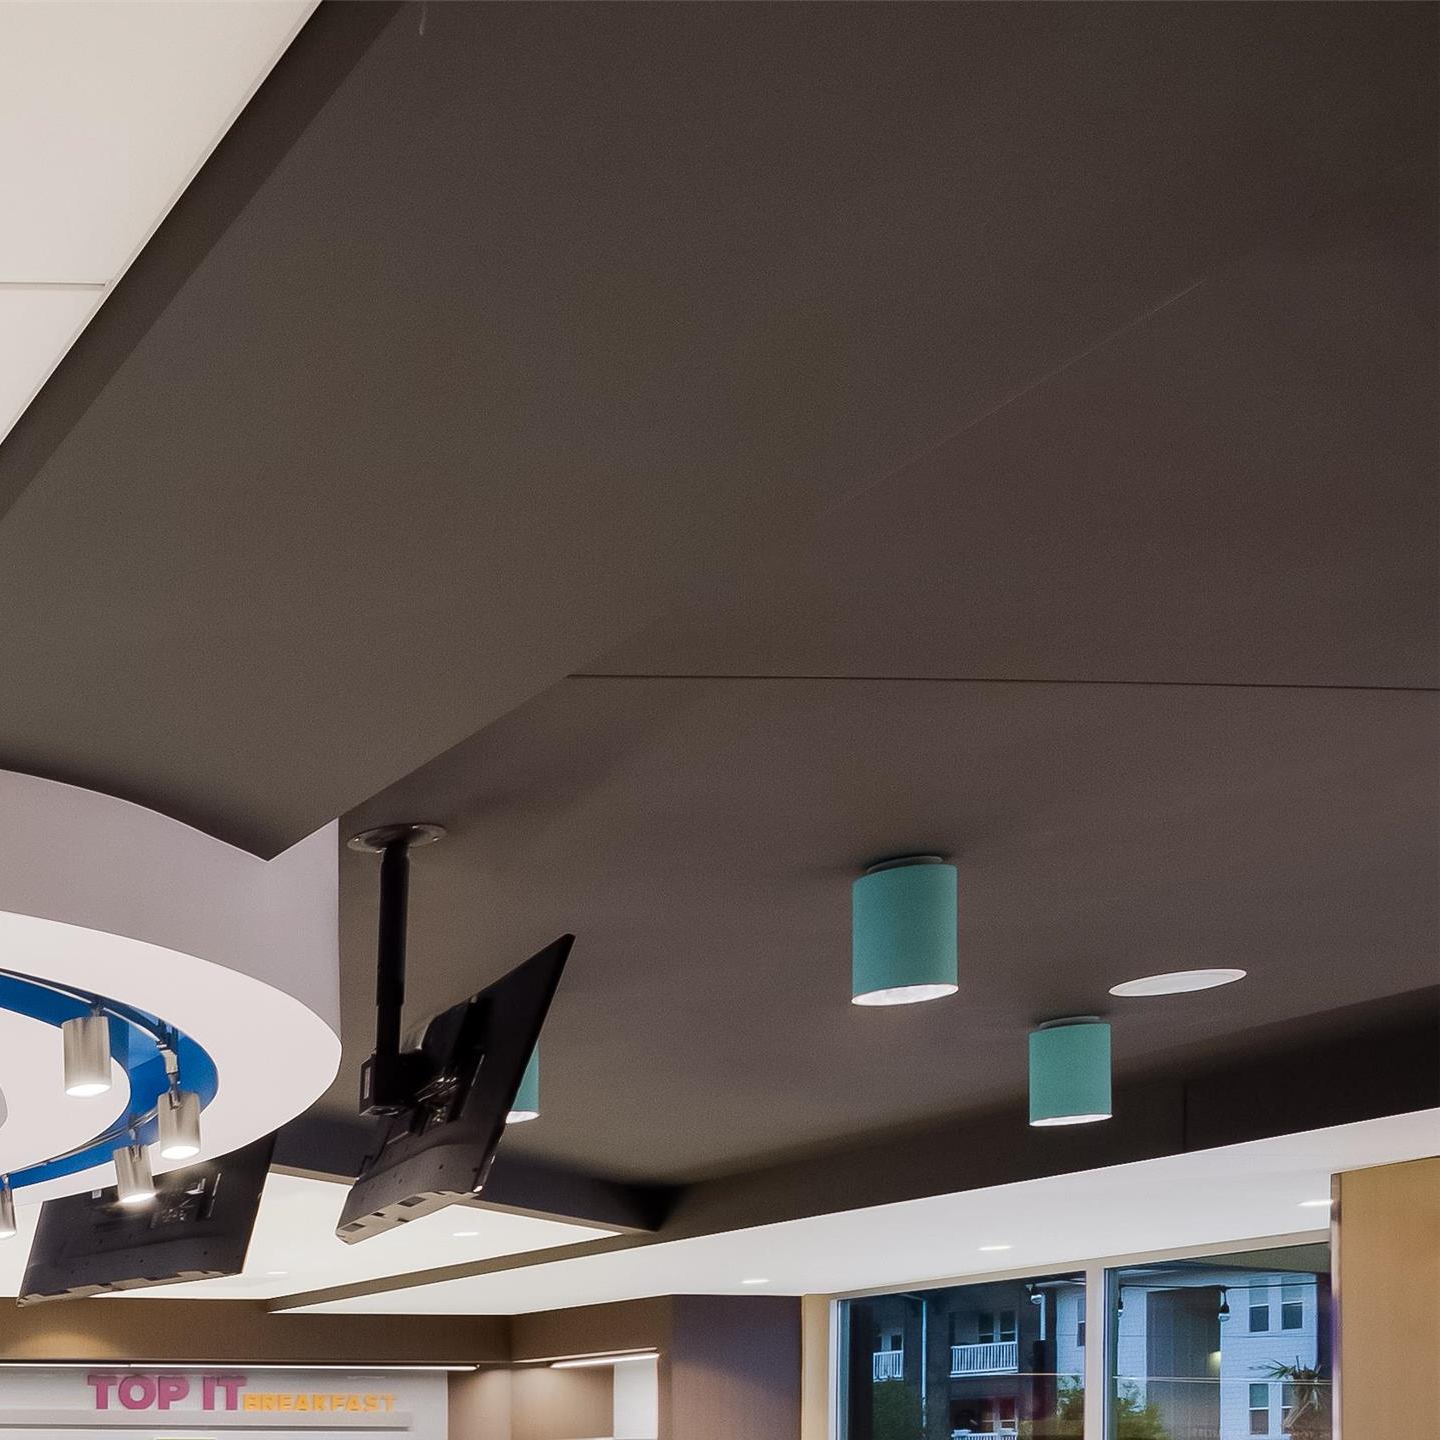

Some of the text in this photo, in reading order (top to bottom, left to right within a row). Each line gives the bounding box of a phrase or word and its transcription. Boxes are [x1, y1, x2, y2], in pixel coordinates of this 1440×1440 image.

[87, 1374, 396, 1413] TOP IT BREAKFAST
